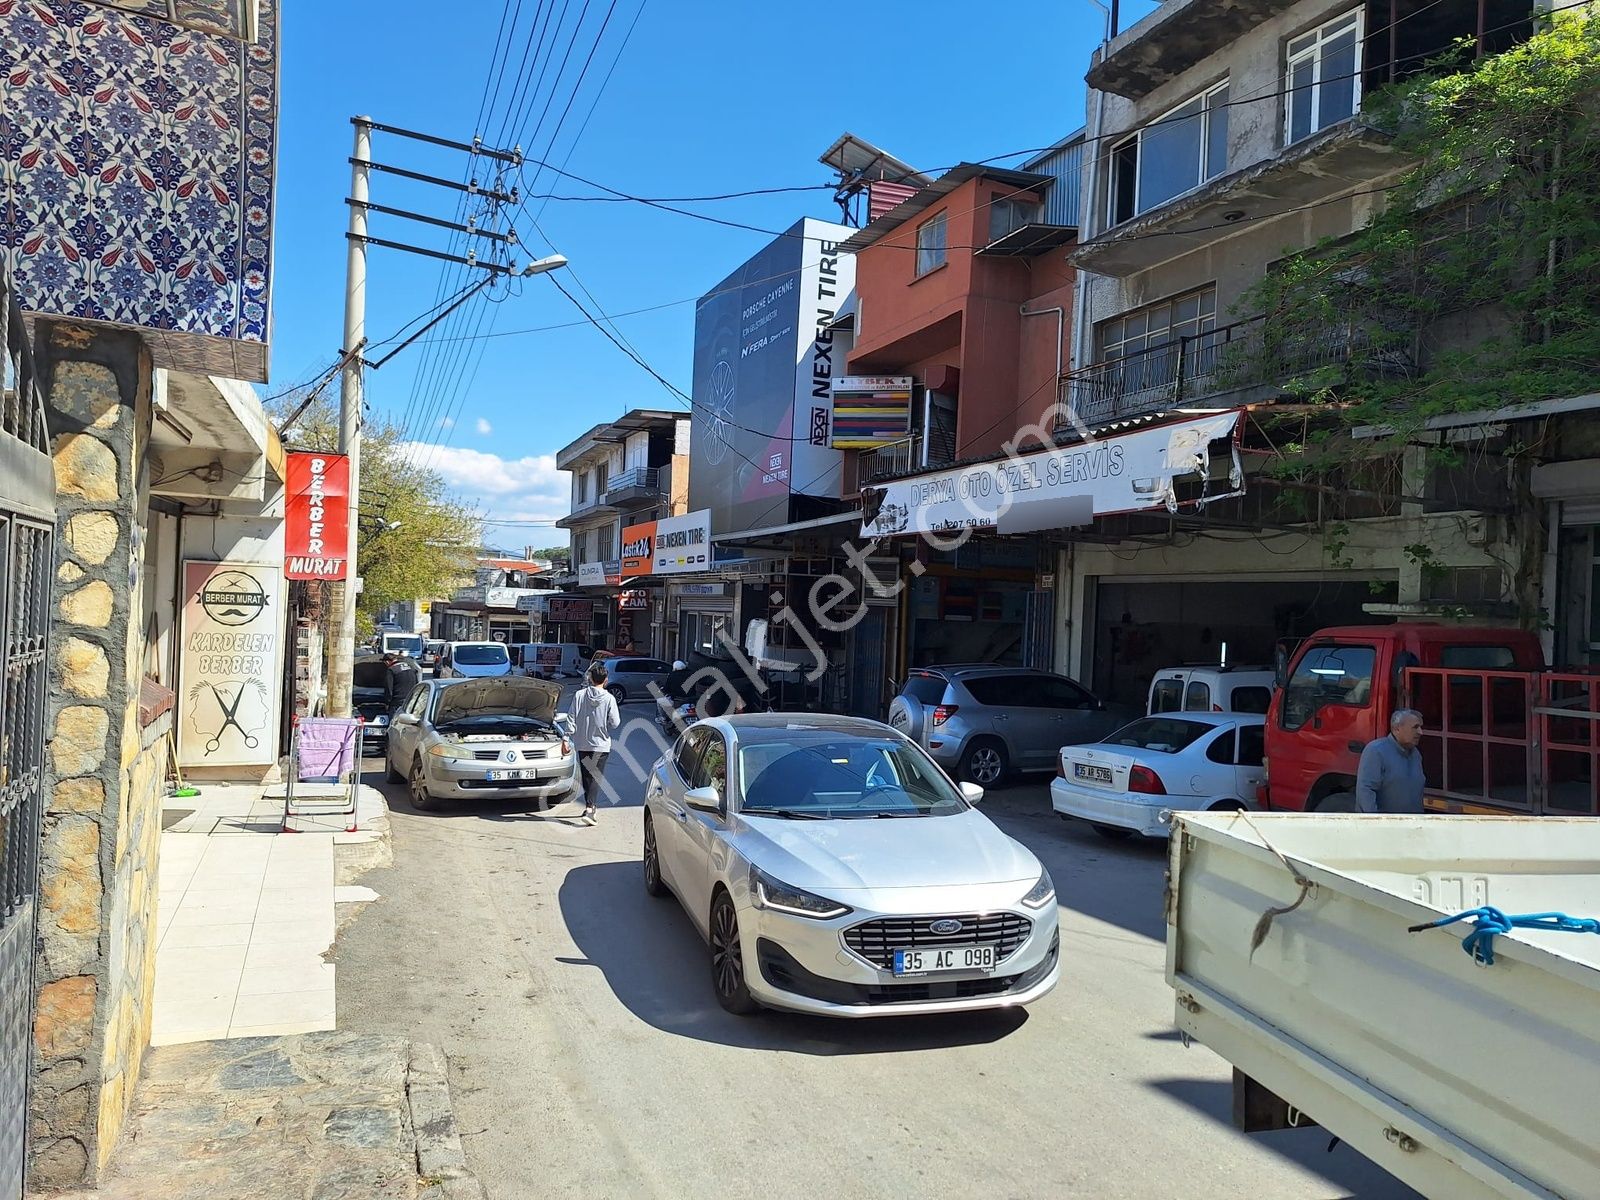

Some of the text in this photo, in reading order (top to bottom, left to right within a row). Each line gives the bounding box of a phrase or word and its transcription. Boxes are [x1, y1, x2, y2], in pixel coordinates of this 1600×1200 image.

[742, 278, 794, 320] PORSCHE CAYENNE
[812, 239, 838, 399] NEXEN TIRE
[910, 441, 1125, 508] DERYA OTO ÖZEL SERVİS
[307, 458, 326, 555] BERBER
[979, 517, 991, 526] 60
[666, 530, 687, 549] NEXEN
[687, 527, 705, 545] TIRE
[289, 557, 342, 576] MURAT
[205, 593, 262, 604] BERBER MURAT
[621, 589, 646, 598] OTO
[189, 632, 275, 653] KARDELEN
[199, 655, 263, 675] BERBER
[493, 771, 501, 779] 35
[937, 921, 955, 931] Ford
[904, 952, 923, 970] 35
[935, 950, 954, 968] AC
[964, 948, 992, 967] 098
